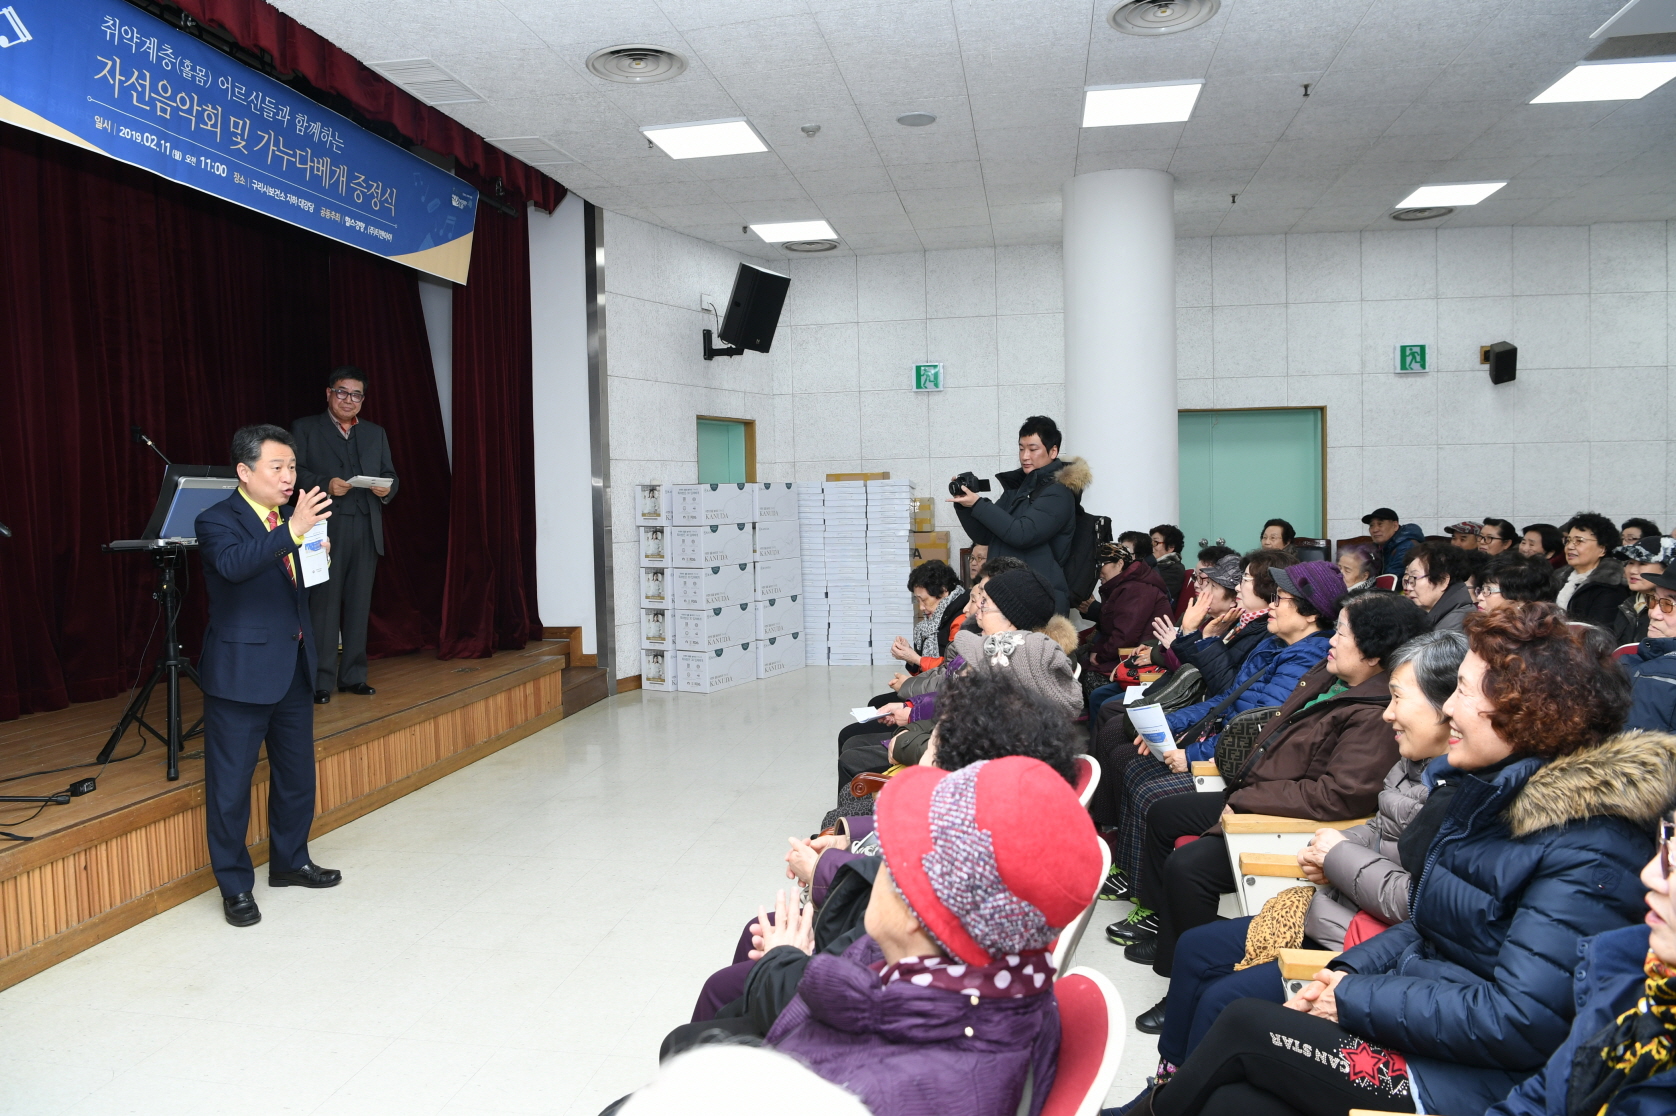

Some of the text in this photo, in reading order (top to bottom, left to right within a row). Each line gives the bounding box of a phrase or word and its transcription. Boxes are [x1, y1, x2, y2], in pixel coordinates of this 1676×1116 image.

[101, 15, 345, 154] 취약계층(홀몸) 어르신들과 함께하는
[94, 55, 397, 217] 자선음악회 및 가누다베개 증정식
[94, 115, 111, 133] 일시
[119, 126, 171, 156] 2019.02.11
[184, 154, 197, 166] 오전
[200, 156, 228, 177] 11:00
[233, 172, 315, 213] 장소 구리시보건소 지하 대강당
[1269, 1031, 1313, 1058] STAR
